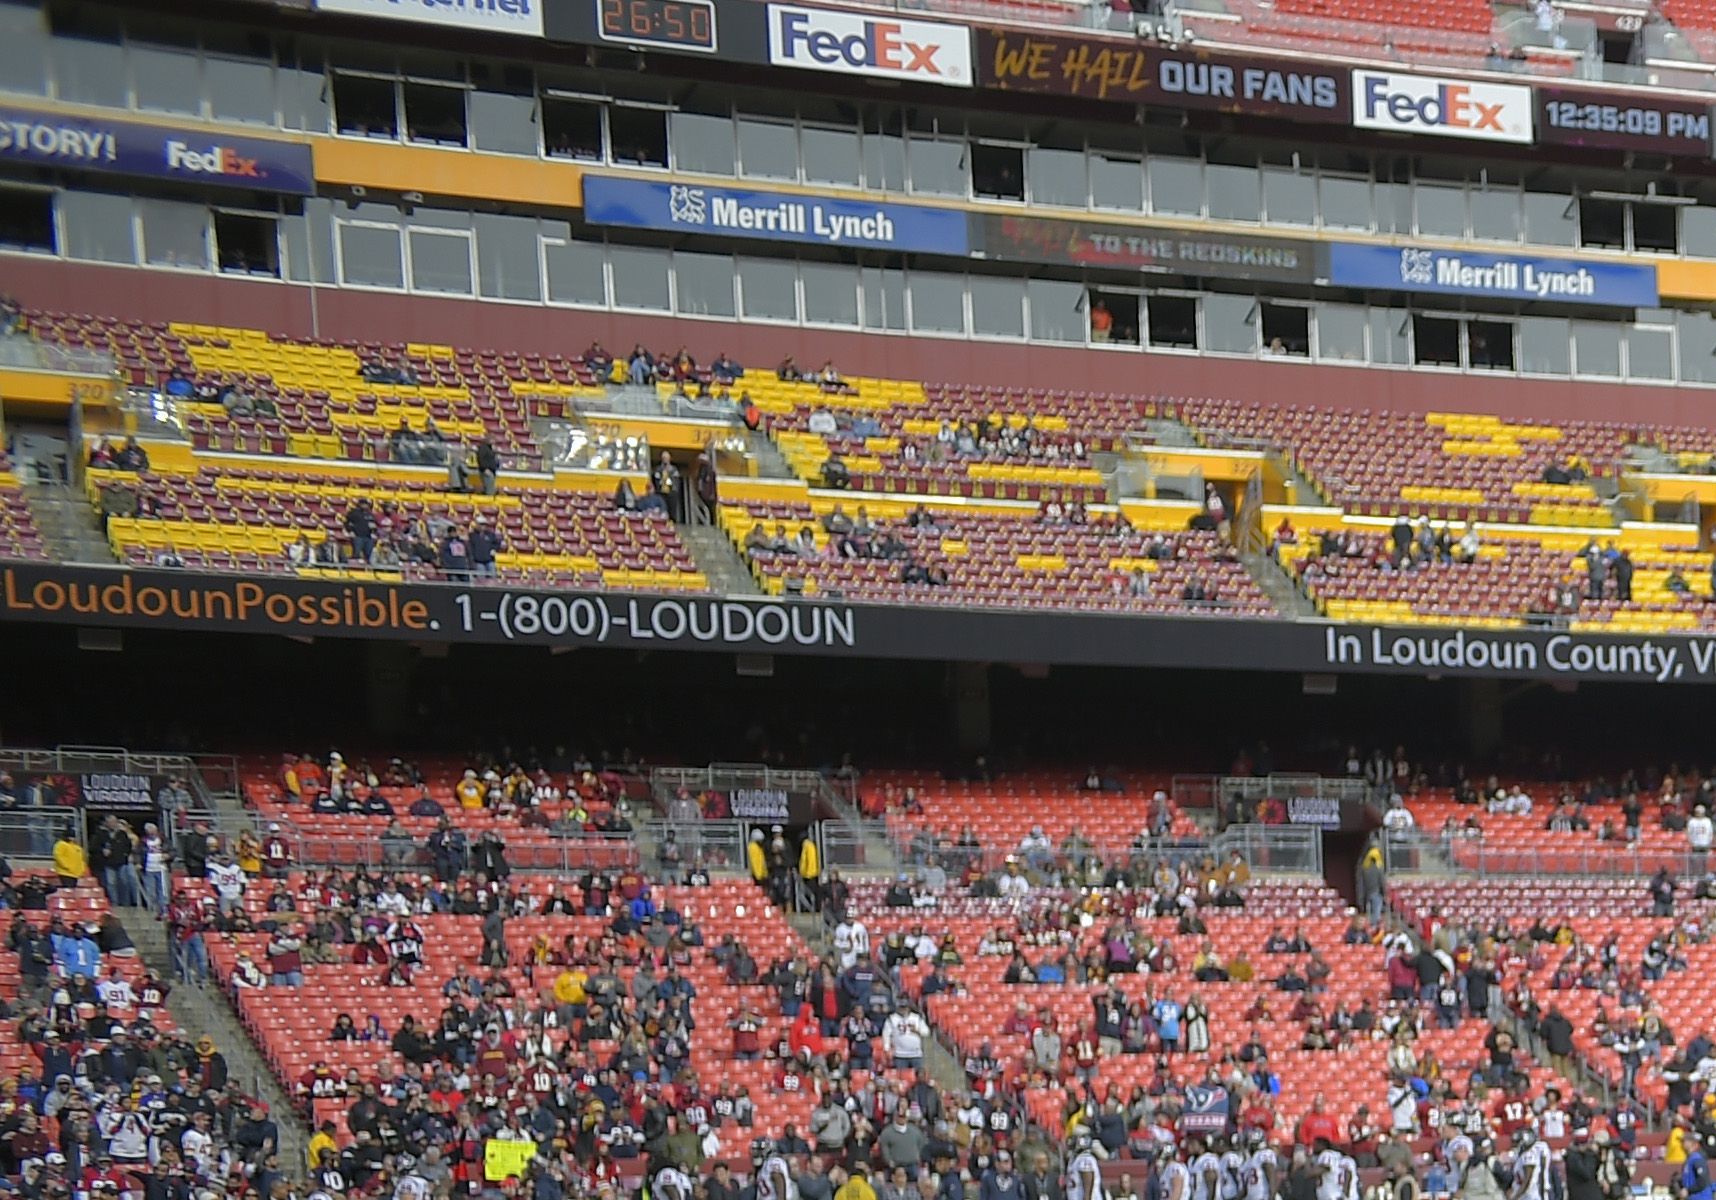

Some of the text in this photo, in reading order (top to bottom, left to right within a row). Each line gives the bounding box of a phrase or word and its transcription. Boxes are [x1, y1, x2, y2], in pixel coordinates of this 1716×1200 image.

[782, 13, 941, 75] FedEx
[993, 40, 1338, 107] WE HAIL OUR FANS
[1364, 75, 1505, 131] FedEx
[1545, 100, 1709, 140] 12:35:09 PM
[166, 140, 260, 178] FedEx
[712, 197, 894, 242] Merrill Lynch
[1437, 257, 1595, 297] Merrill Lynch
[0, 566, 854, 648] LoudounPossible. 1-(800)-LOUDOUN
[1327, 627, 1361, 664] In
[1372, 627, 1537, 671] Loudoun
[1545, 635, 1683, 683] County,
[82, 774, 152, 790] LOUDOUN
[83, 789, 152, 803] VIRGINIA
[142, 989, 160, 1004] 10
[1077, 1040, 1093, 1061] 11
[533, 1073, 550, 1092] 10
[1504, 1102, 1524, 1121] 17
